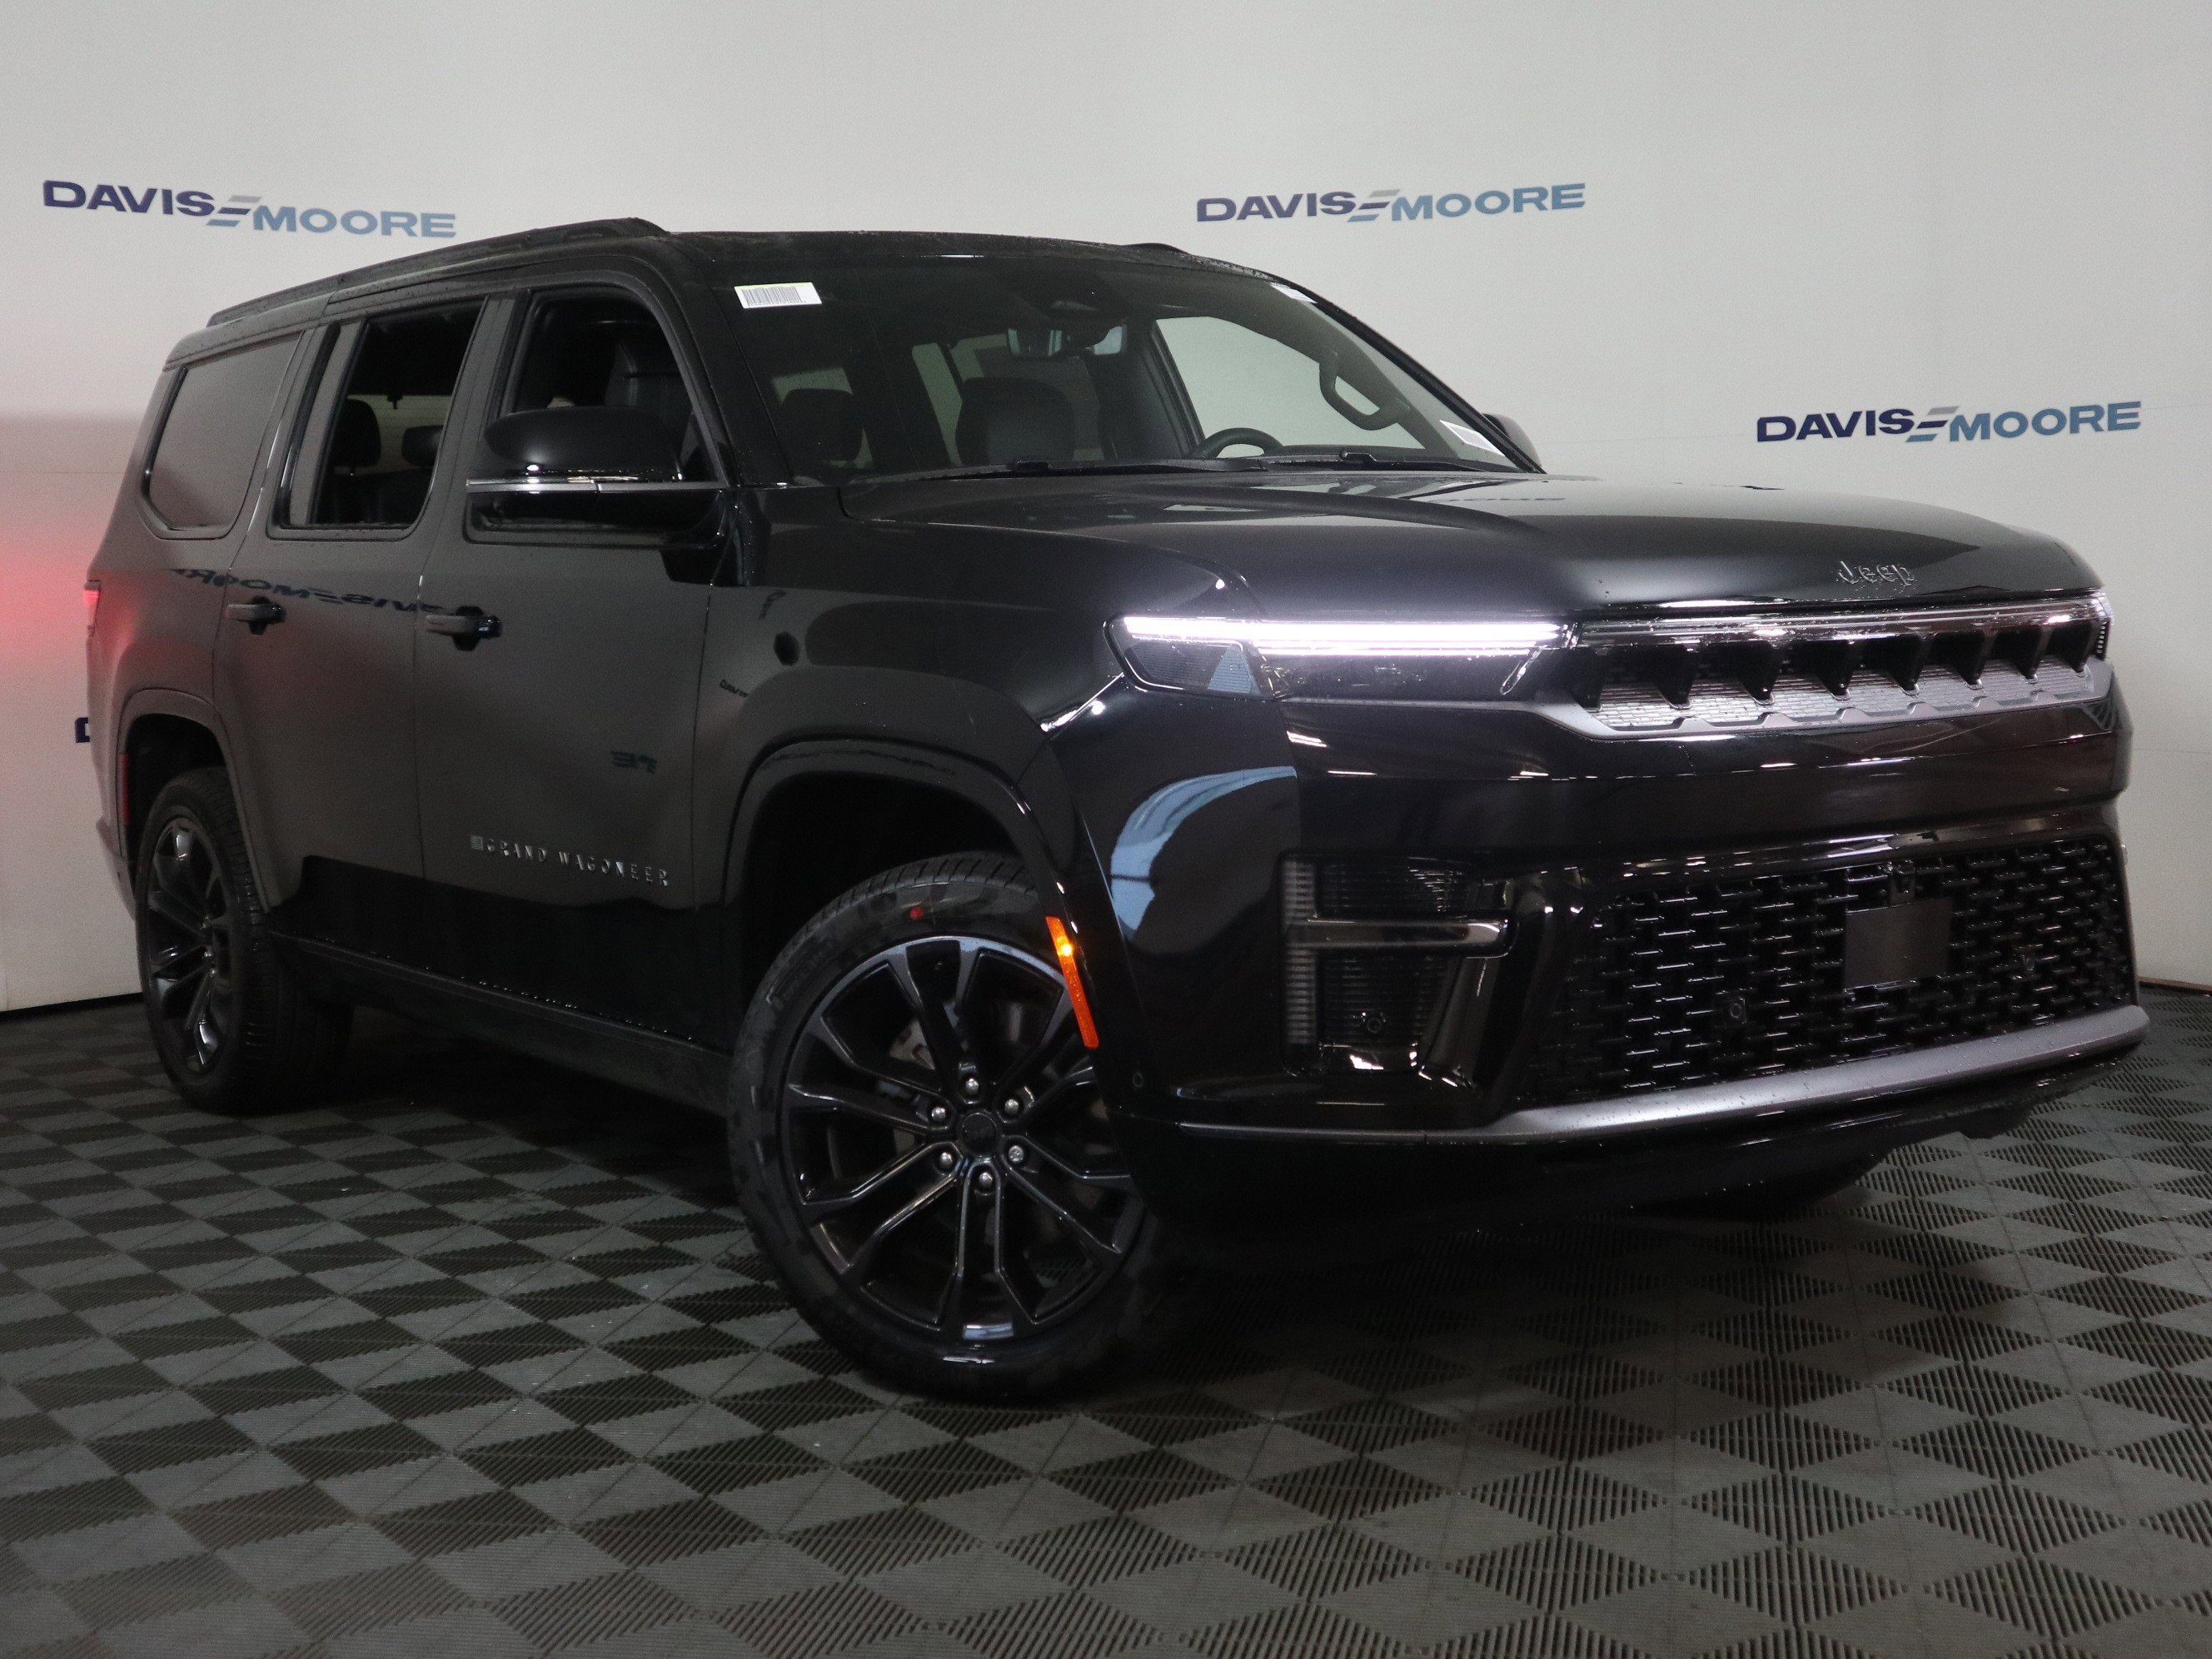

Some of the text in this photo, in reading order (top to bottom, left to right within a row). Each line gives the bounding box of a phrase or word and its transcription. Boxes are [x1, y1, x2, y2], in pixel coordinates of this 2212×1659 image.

[42, 179, 457, 239] DAVIS MOORE
[1196, 182, 1587, 222] DAVIS MOORE
[1756, 400, 2143, 443] DAVIS MOORE
[1836, 560, 1916, 588] Jeep
[486, 838, 670, 888] GRAND WAGONEER
